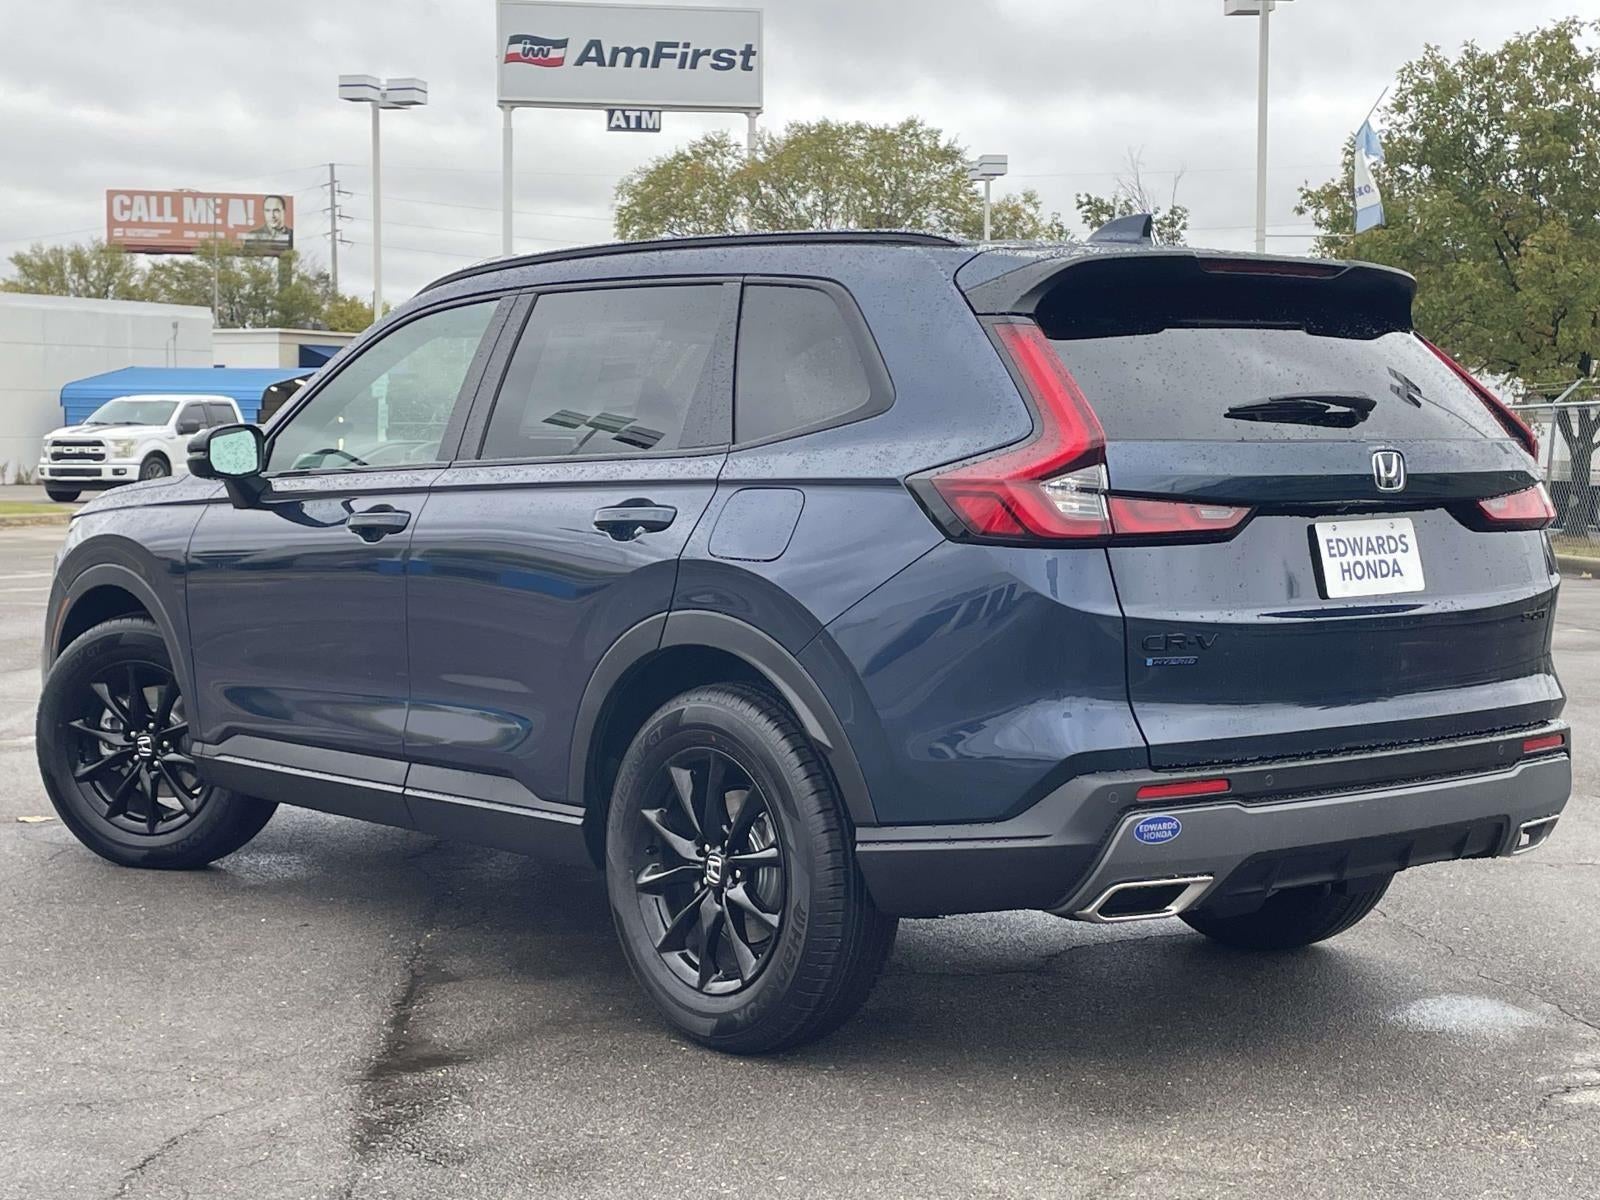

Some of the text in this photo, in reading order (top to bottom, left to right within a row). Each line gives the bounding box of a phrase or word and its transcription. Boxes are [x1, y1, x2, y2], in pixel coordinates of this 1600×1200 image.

[573, 39, 757, 72] AmFirst
[609, 110, 660, 129] ATM
[112, 194, 179, 224] CALL
[183, 197, 223, 225] ME
[1326, 534, 1409, 558] EDWARDS
[1340, 558, 1403, 581] HONDA
[1141, 632, 1219, 651] CR-V
[1139, 821, 1178, 833] EDWARDS
[1143, 830, 1173, 840] HONDA
